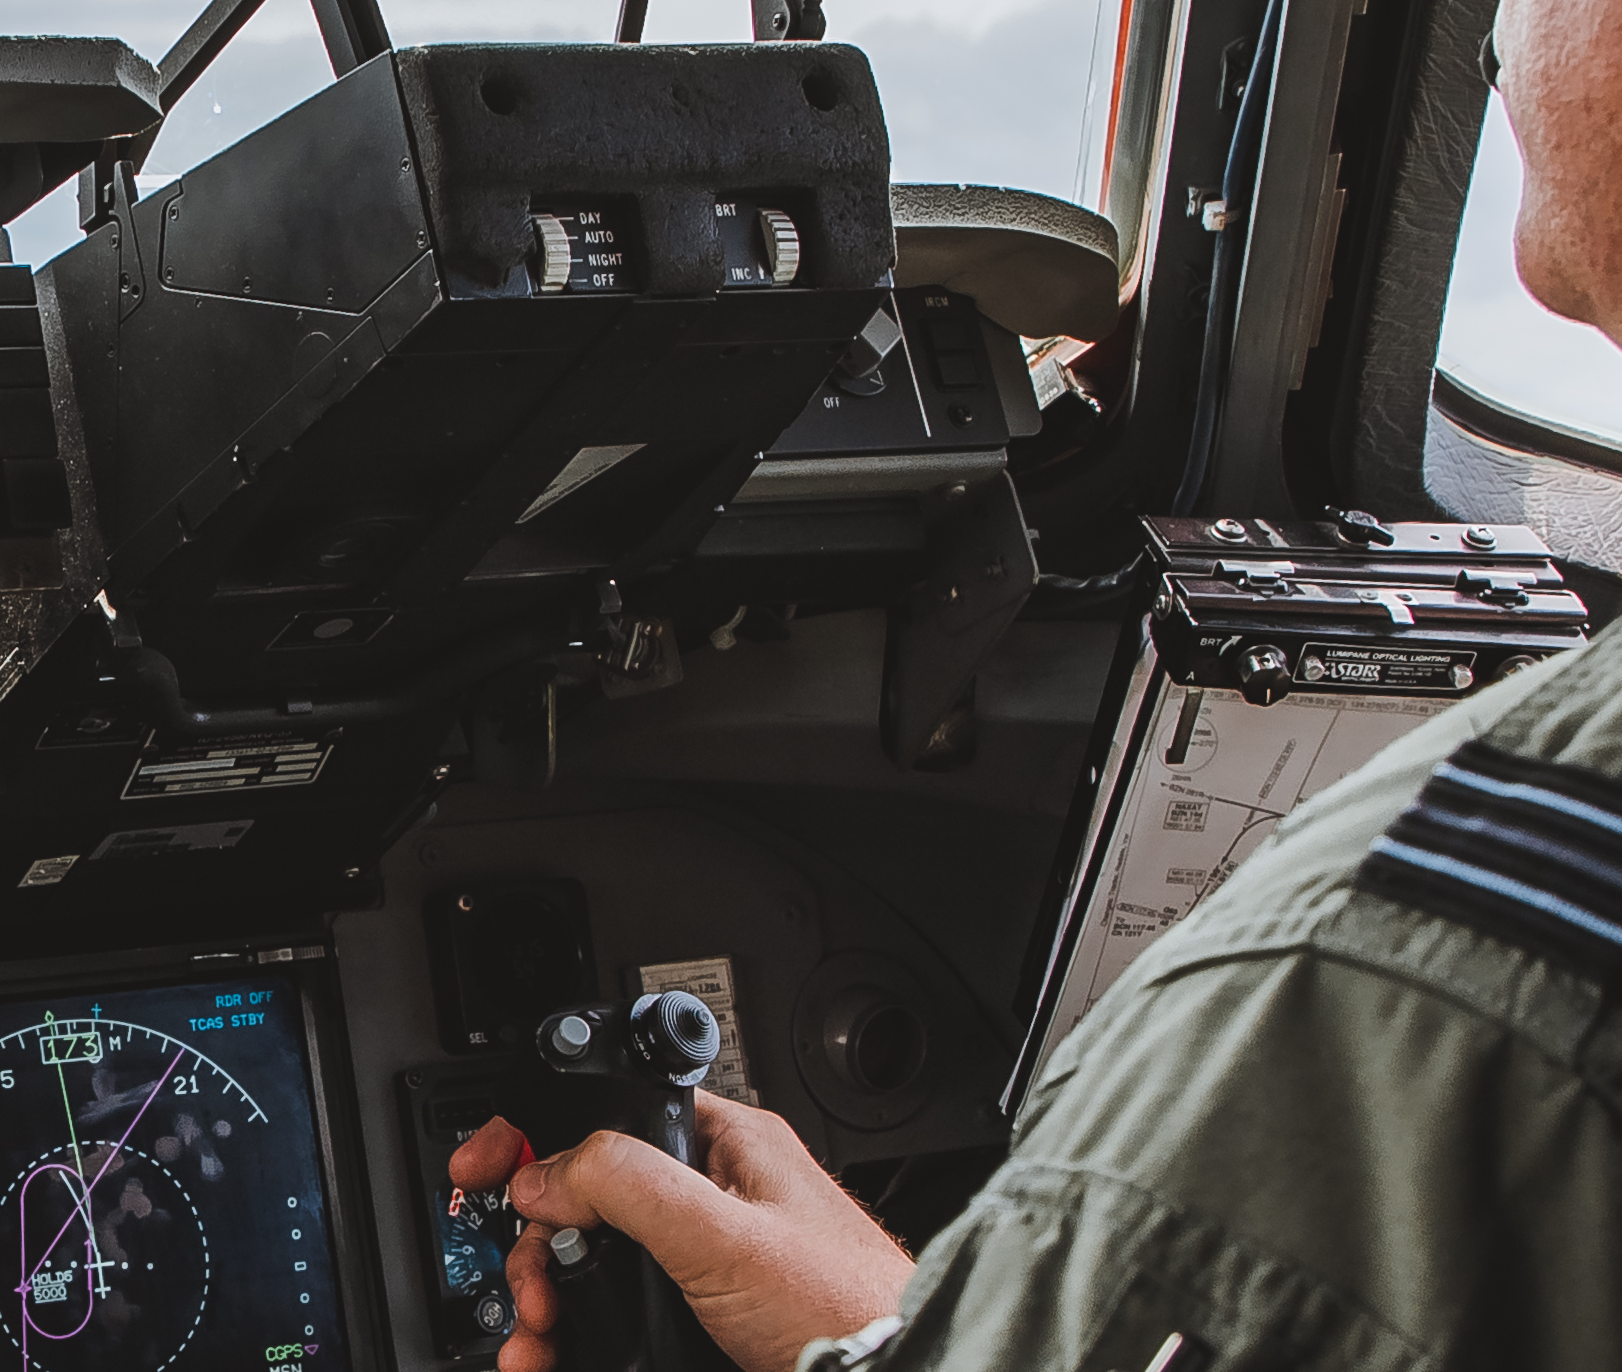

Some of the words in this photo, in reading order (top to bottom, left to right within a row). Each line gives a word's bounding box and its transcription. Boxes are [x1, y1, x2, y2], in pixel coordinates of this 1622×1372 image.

[716, 203, 737, 218] BRT
[579, 212, 602, 225] DAY
[584, 231, 614, 245] AUTO
[588, 253, 624, 267] NIGHT
[592, 274, 615, 287] OFF
[732, 267, 752, 282] INC
[1199, 636, 1223, 648] BRT
[1372, 653, 1407, 661] OPTICAL
[1410, 655, 1450, 663] LIGHTING
[215, 992, 244, 1007] RDR
[248, 990, 273, 1005] OFF
[189, 1016, 225, 1031] TCAS
[230, 1011, 266, 1027] STBY
[469, 1033, 488, 1044] SEL
